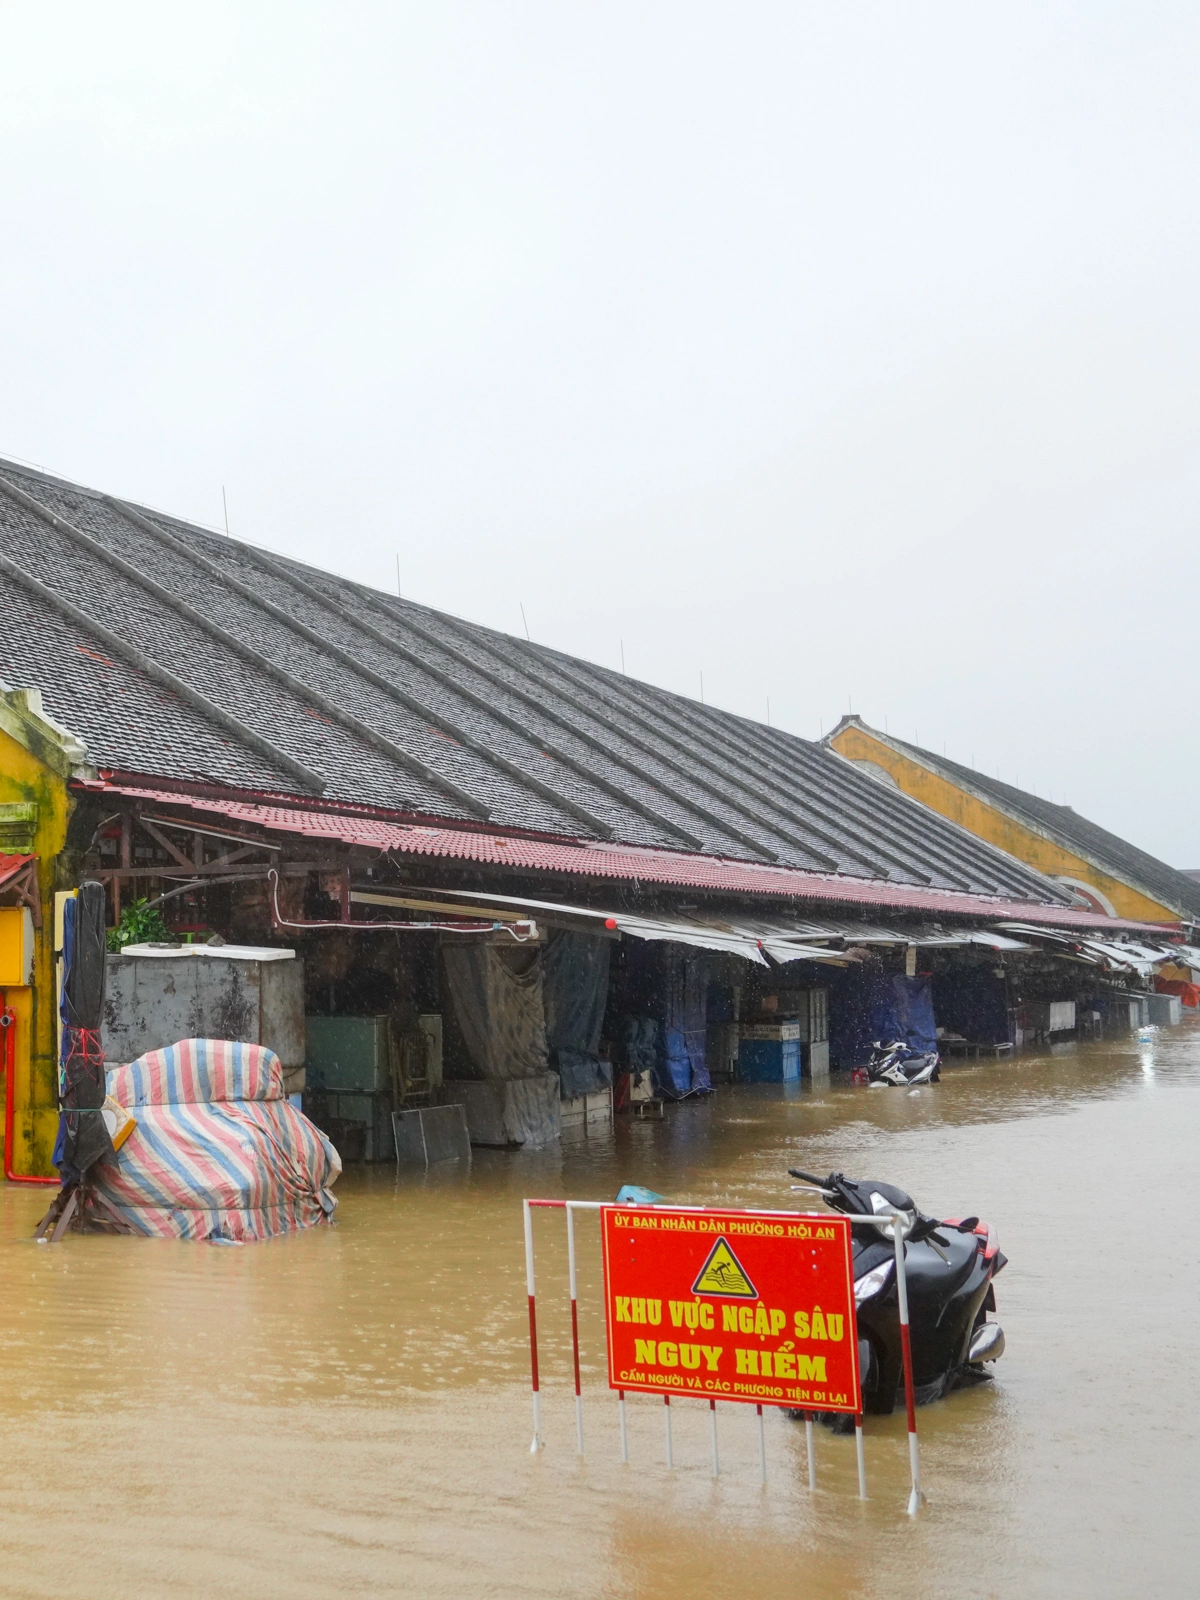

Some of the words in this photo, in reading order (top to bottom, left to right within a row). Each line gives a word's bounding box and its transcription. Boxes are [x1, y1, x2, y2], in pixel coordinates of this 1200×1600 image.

[614, 1212, 630, 1227] ỦY
[632, 1216, 658, 1229] BAN
[660, 1216, 696, 1231] NHÂN
[699, 1218, 726, 1233] DÂN
[729, 1220, 785, 1236] PHƯỜNG
[787, 1223, 812, 1240] HỘI
[815, 1227, 836, 1239] AN
[615, 1295, 663, 1326] KHU
[668, 1296, 715, 1336] VỰC
[721, 1300, 787, 1342] NGẬP
[793, 1305, 844, 1342] SÂU
[634, 1338, 723, 1371] NGUY
[735, 1340, 828, 1383] HIỂM
[620, 1368, 646, 1382] CẤM
[648, 1373, 684, 1387] NGƯỜI
[686, 1376, 702, 1389] VÀ
[705, 1378, 731, 1391] CÁC
[733, 1382, 784, 1397] PHƯƠNG
[785, 1386, 810, 1402] TIỆN
[813, 1390, 826, 1401] ĐI
[829, 1392, 848, 1406] LẠI
